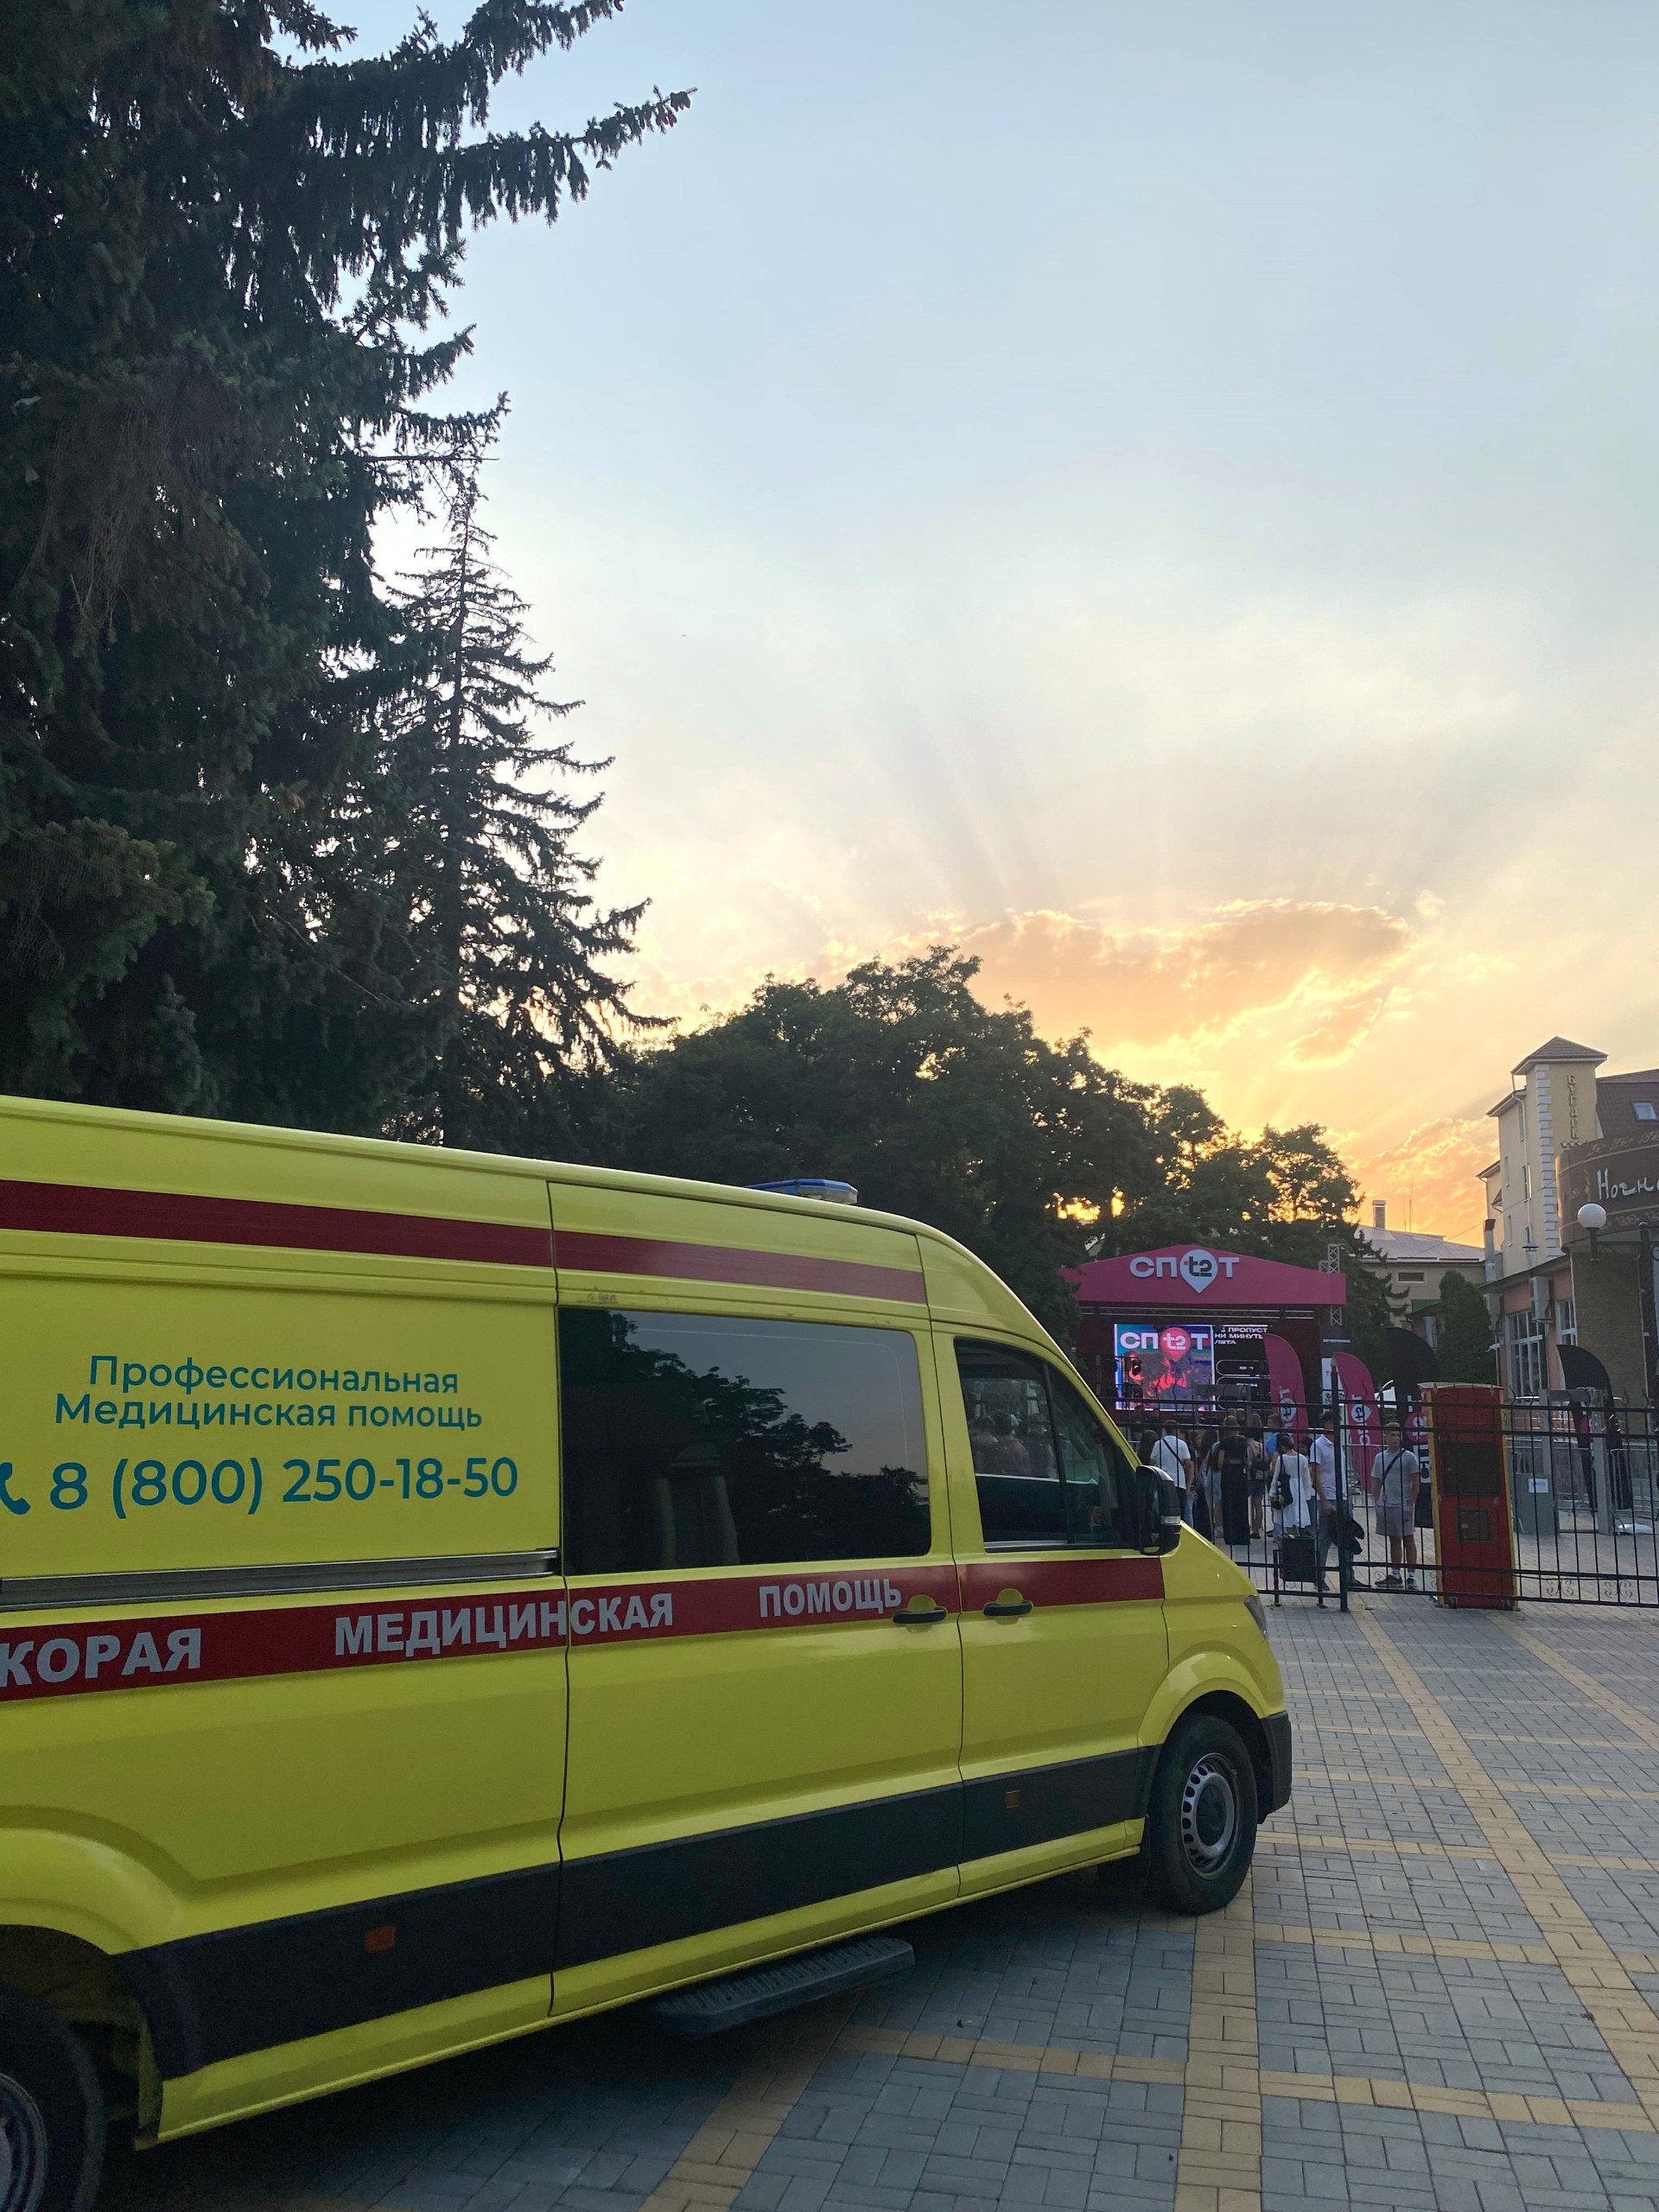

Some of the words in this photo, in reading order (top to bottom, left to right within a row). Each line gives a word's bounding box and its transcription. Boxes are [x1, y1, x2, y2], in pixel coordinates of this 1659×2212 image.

[1597, 1167, 1659, 1200] Ночн
[89, 1356, 459, 1394] Профессиональная
[54, 1393, 335, 1430] Медицинская
[347, 1404, 482, 1431] помощь
[49, 1462, 88, 1510] 8
[112, 1457, 263, 1519] (800)
[283, 1457, 518, 1503] 250-18-50
[0, 1627, 202, 1688] КОРАЯ
[334, 1592, 674, 1658] МЕДИЦИНСКАЯ
[759, 1578, 902, 1618] ПОМОЩЬ
